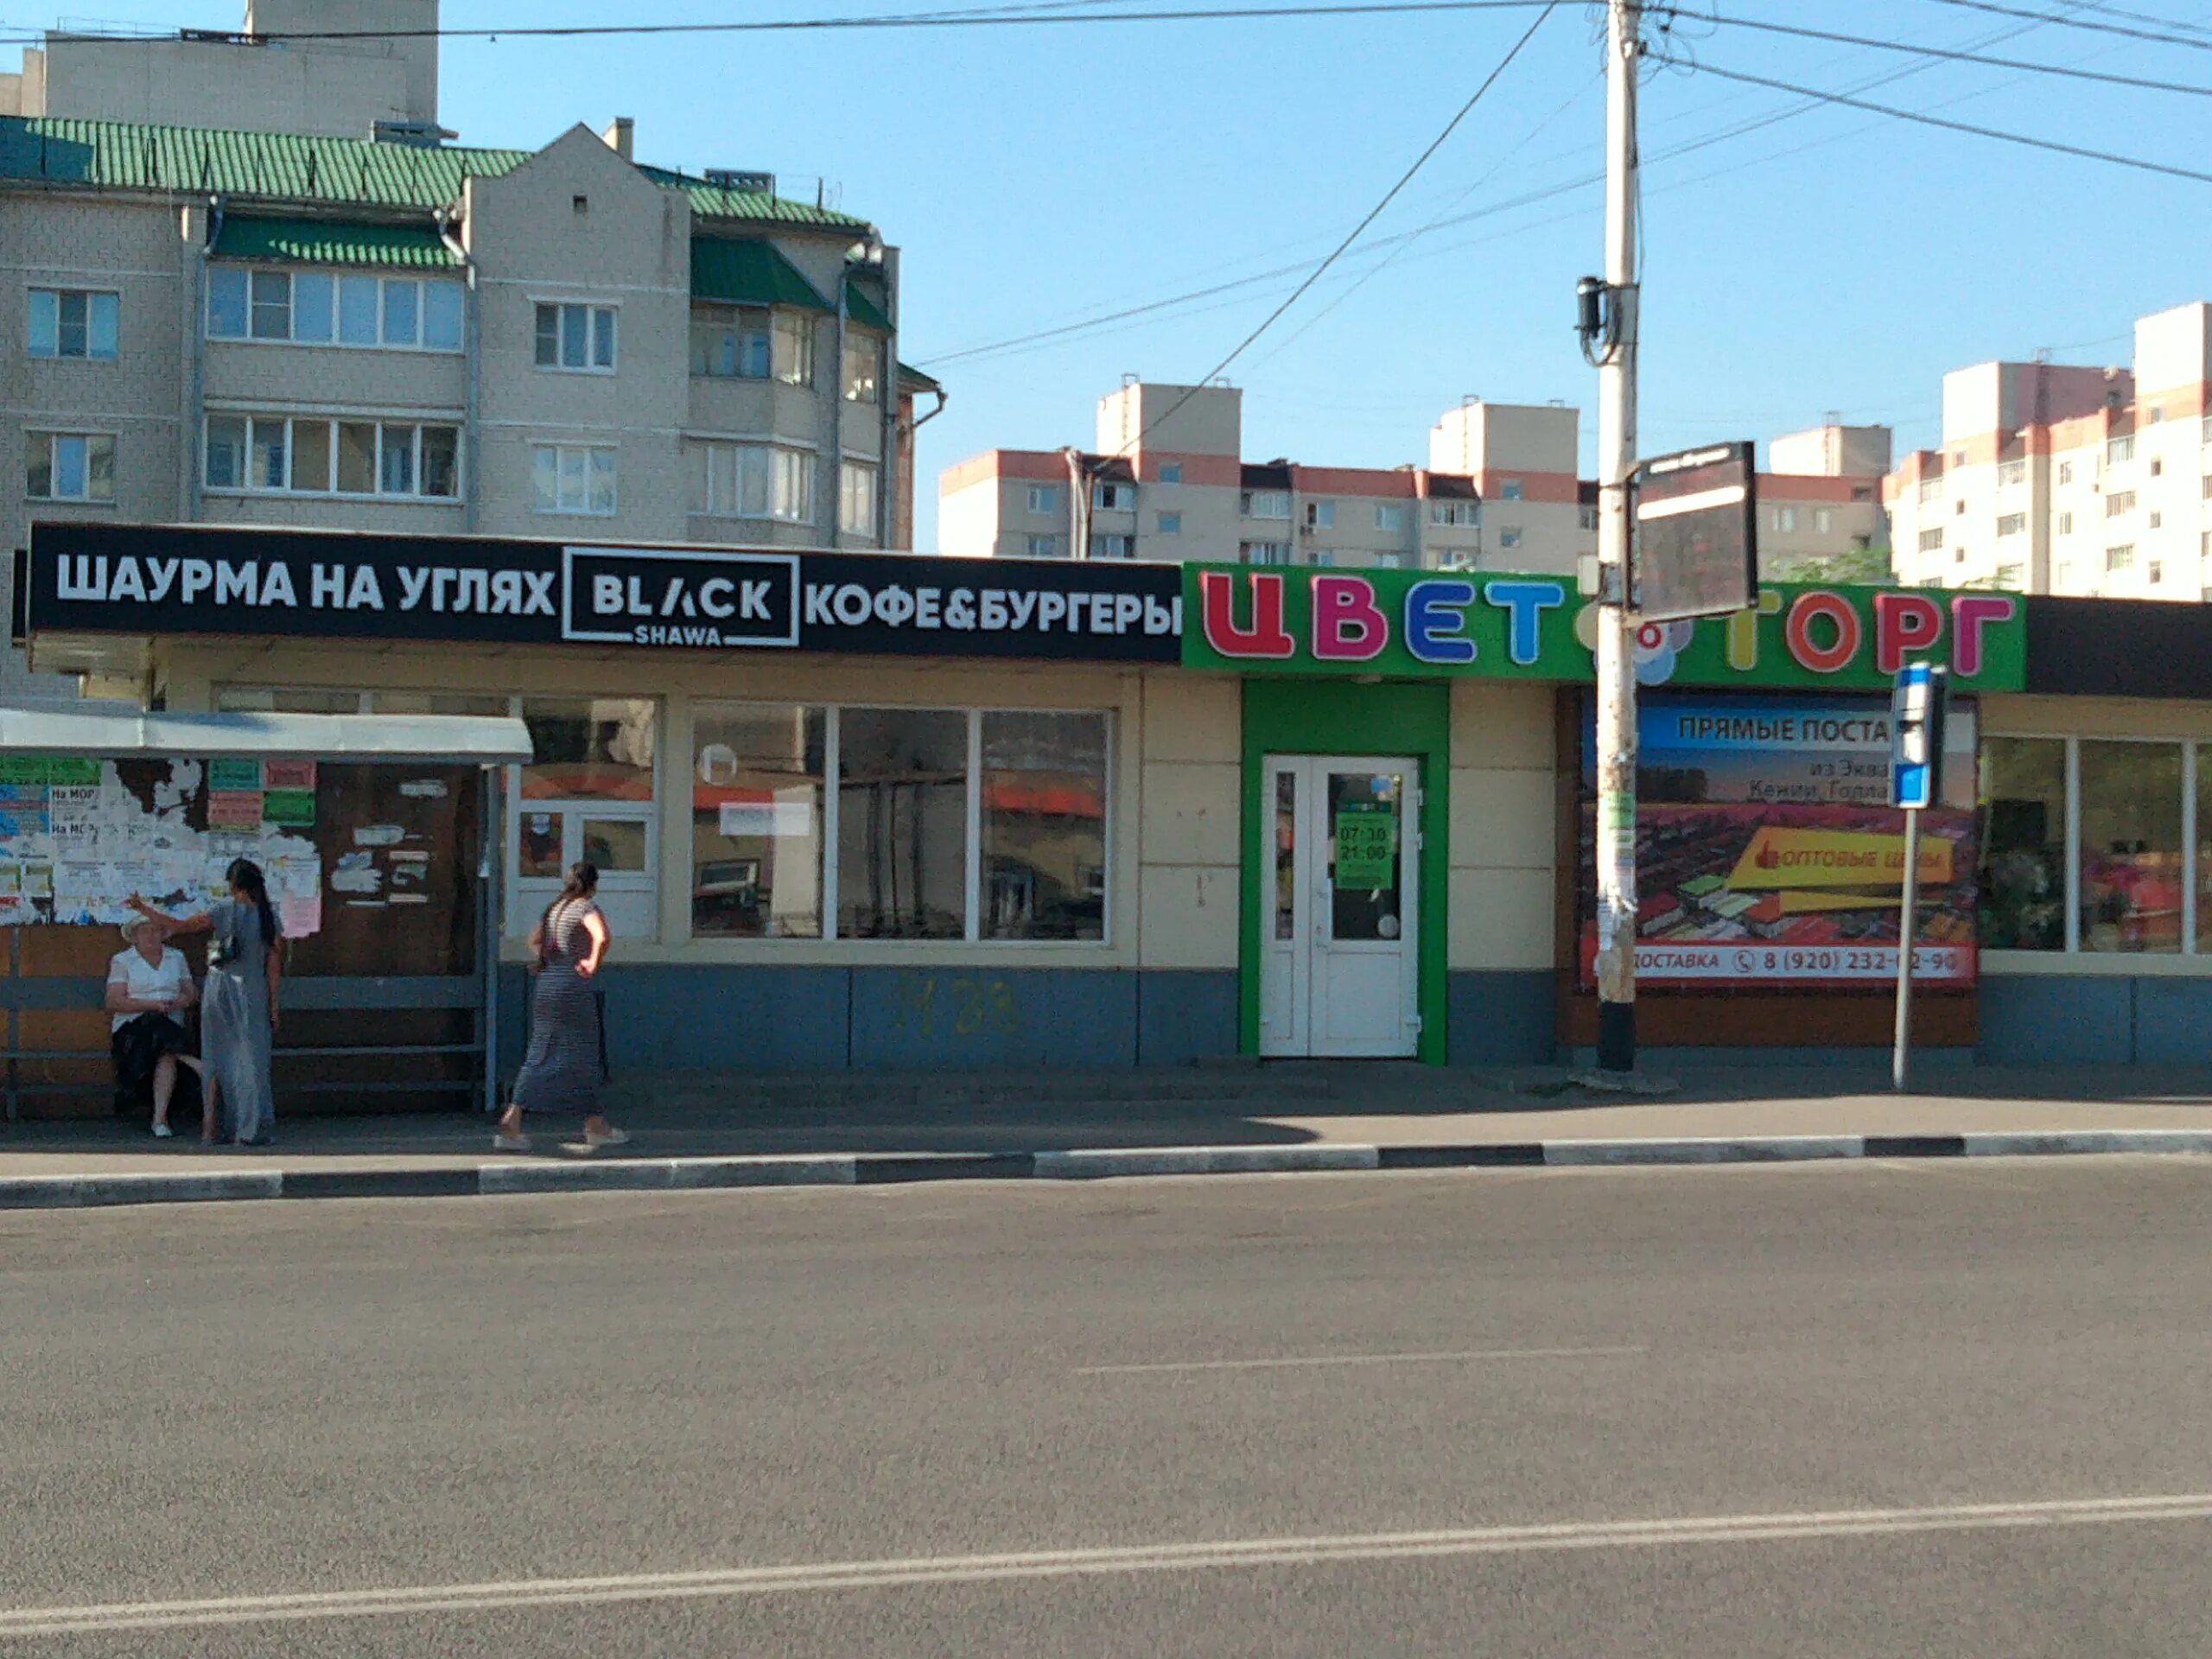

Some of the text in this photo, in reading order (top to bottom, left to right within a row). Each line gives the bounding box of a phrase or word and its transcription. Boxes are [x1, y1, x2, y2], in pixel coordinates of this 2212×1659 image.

[57, 553, 556, 616] ШАУРМА НА УГЛЯХ
[593, 574, 772, 620] BLACK
[804, 583, 1182, 636] КОФЕ&БУРГЕРЫ
[1199, 571, 2016, 677] ЦВЕТ ТОРГ
[633, 625, 721, 645] SHAWA
[1679, 716, 1890, 743] ПРЯМЫЕ ПОСТА
[1839, 760, 1890, 778] Эква
[70, 788, 99, 800] МОР
[1827, 780, 1890, 799] Голла
[1884, 850, 1942, 868] ЦЕЫ
[1764, 951, 1957, 971] 8 (920) 232-2-90
